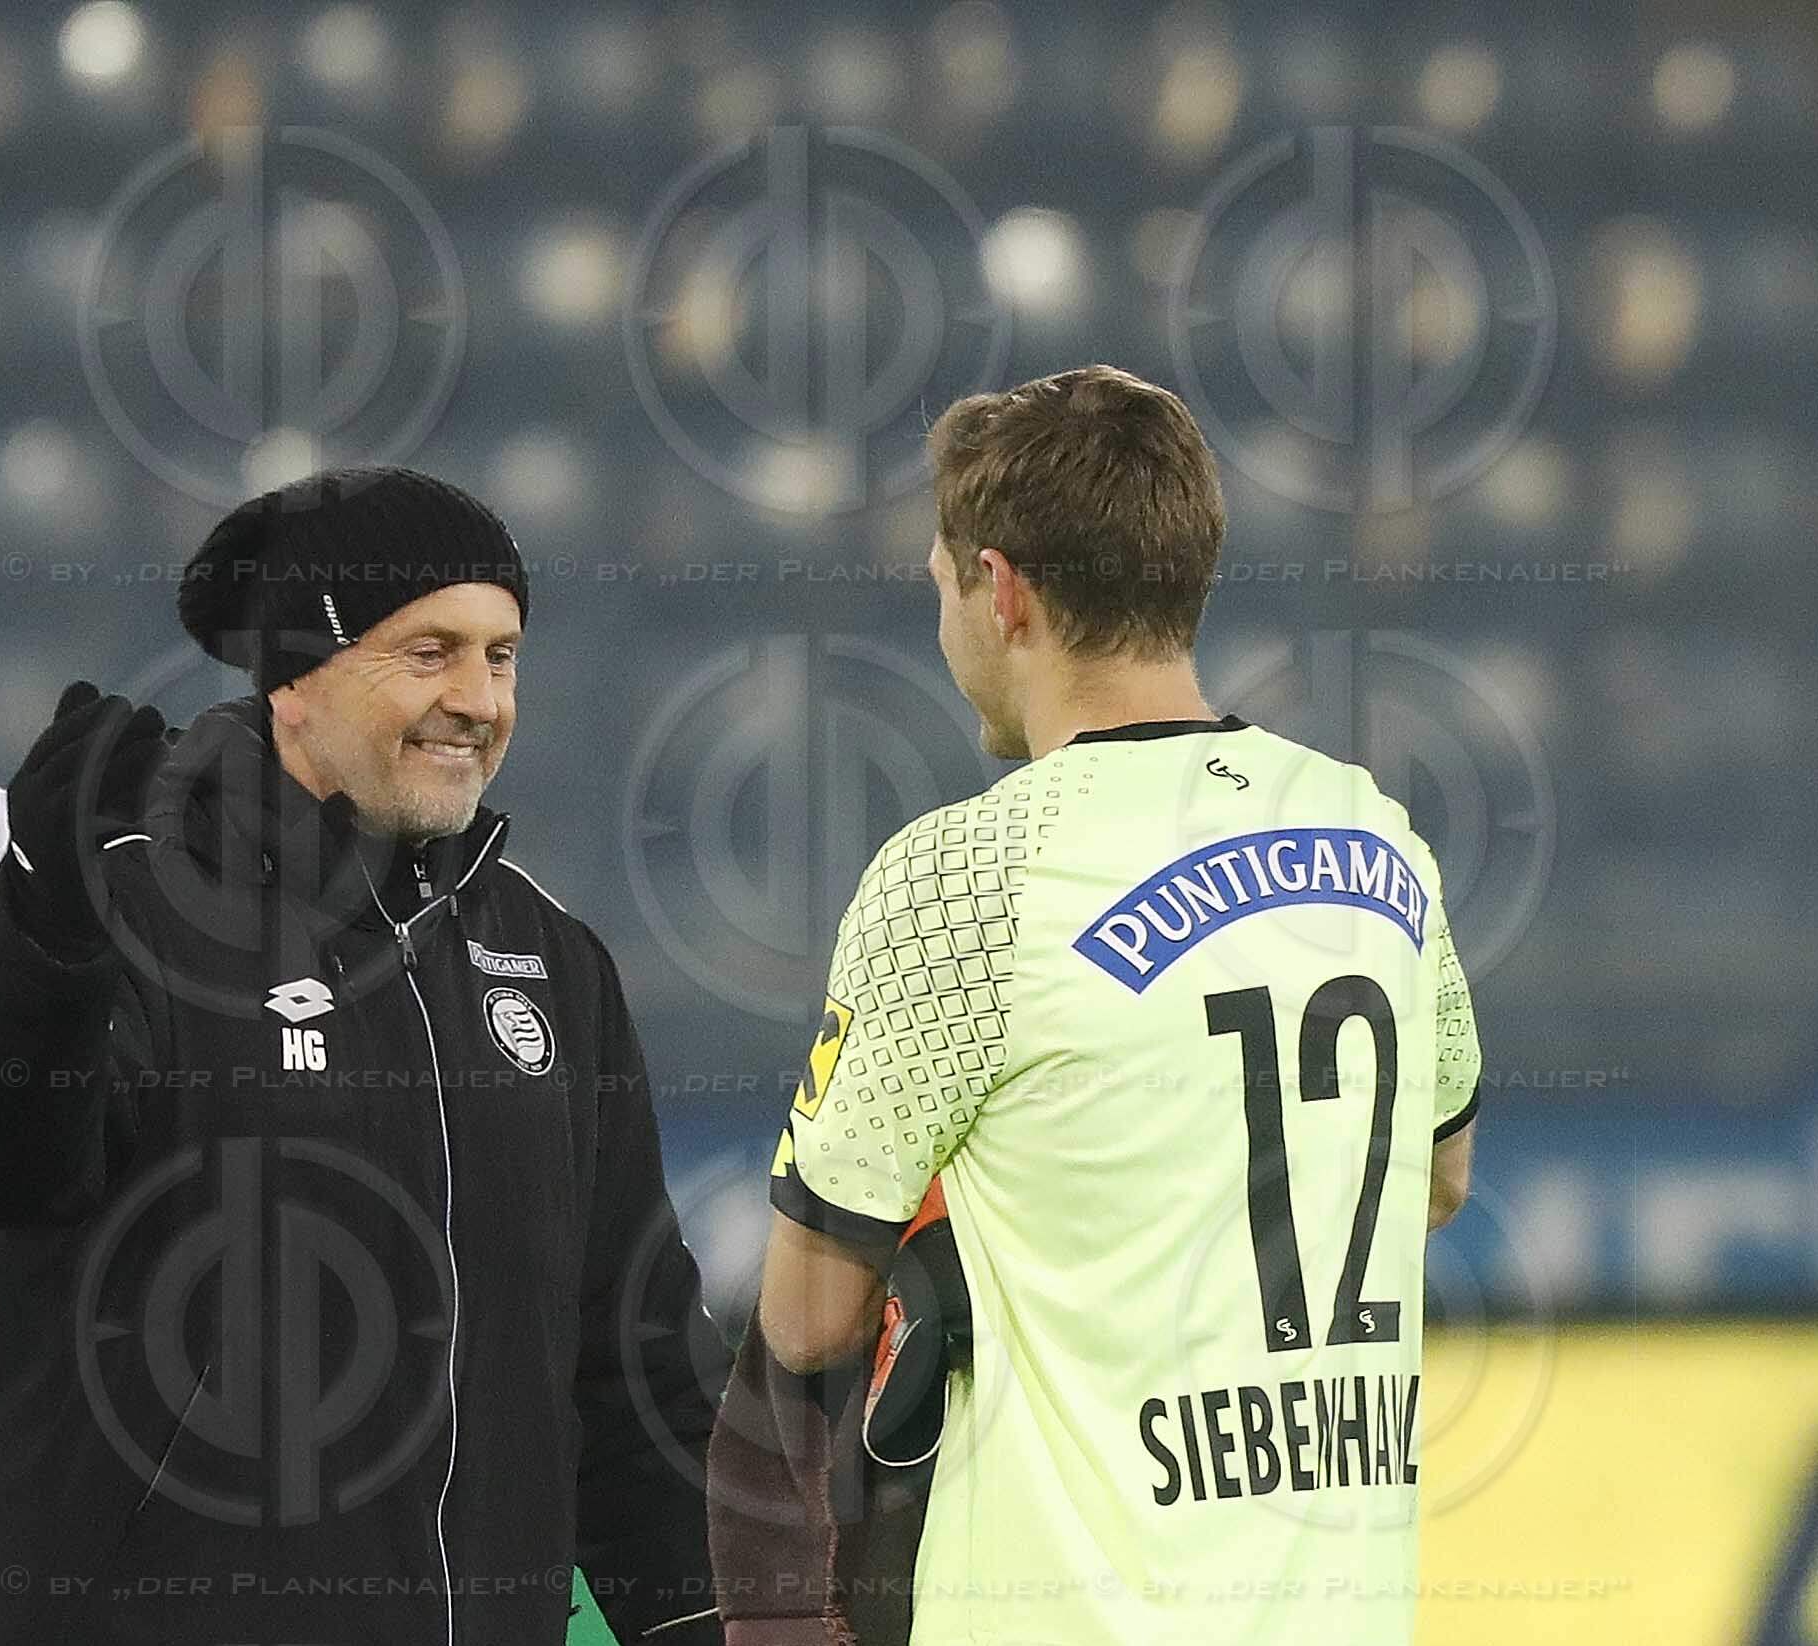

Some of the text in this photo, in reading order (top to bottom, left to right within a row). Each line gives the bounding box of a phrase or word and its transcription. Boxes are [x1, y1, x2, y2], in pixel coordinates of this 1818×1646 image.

[1094, 839, 1422, 976] PUNTIGAMER
[282, 1027, 328, 1072] HG
[1203, 974, 1401, 1354] 12
